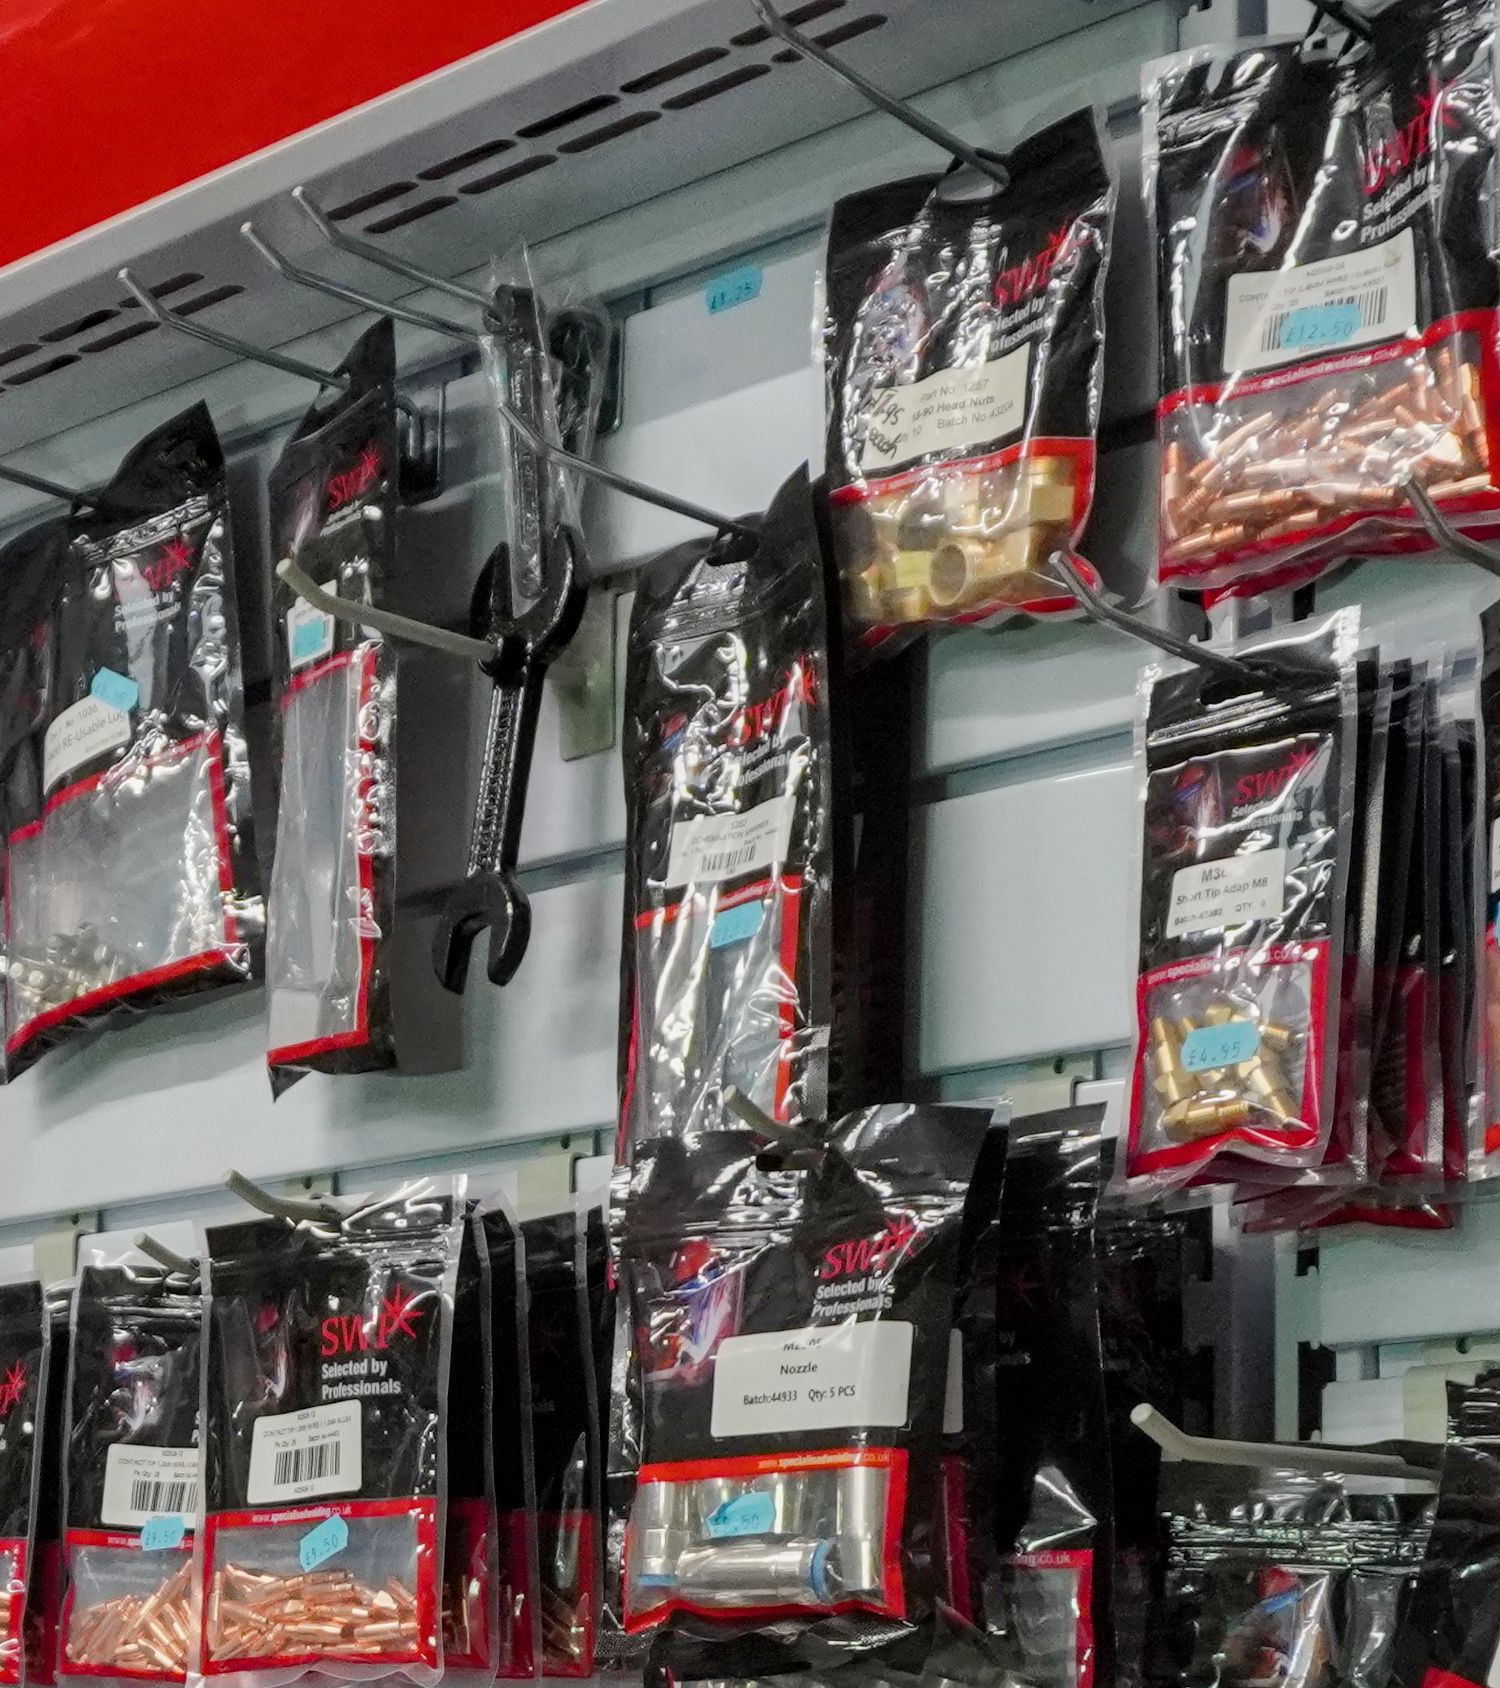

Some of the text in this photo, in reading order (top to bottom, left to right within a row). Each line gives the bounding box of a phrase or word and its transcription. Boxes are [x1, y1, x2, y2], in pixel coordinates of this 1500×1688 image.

[937, 400, 965, 413] Head
[970, 395, 994, 406] Nuts
[811, 1294, 893, 1318] Professionals
[322, 1357, 388, 1379] Selected by
[780, 1362, 818, 1375] Nozzle
[322, 1379, 401, 1400] Professionals
